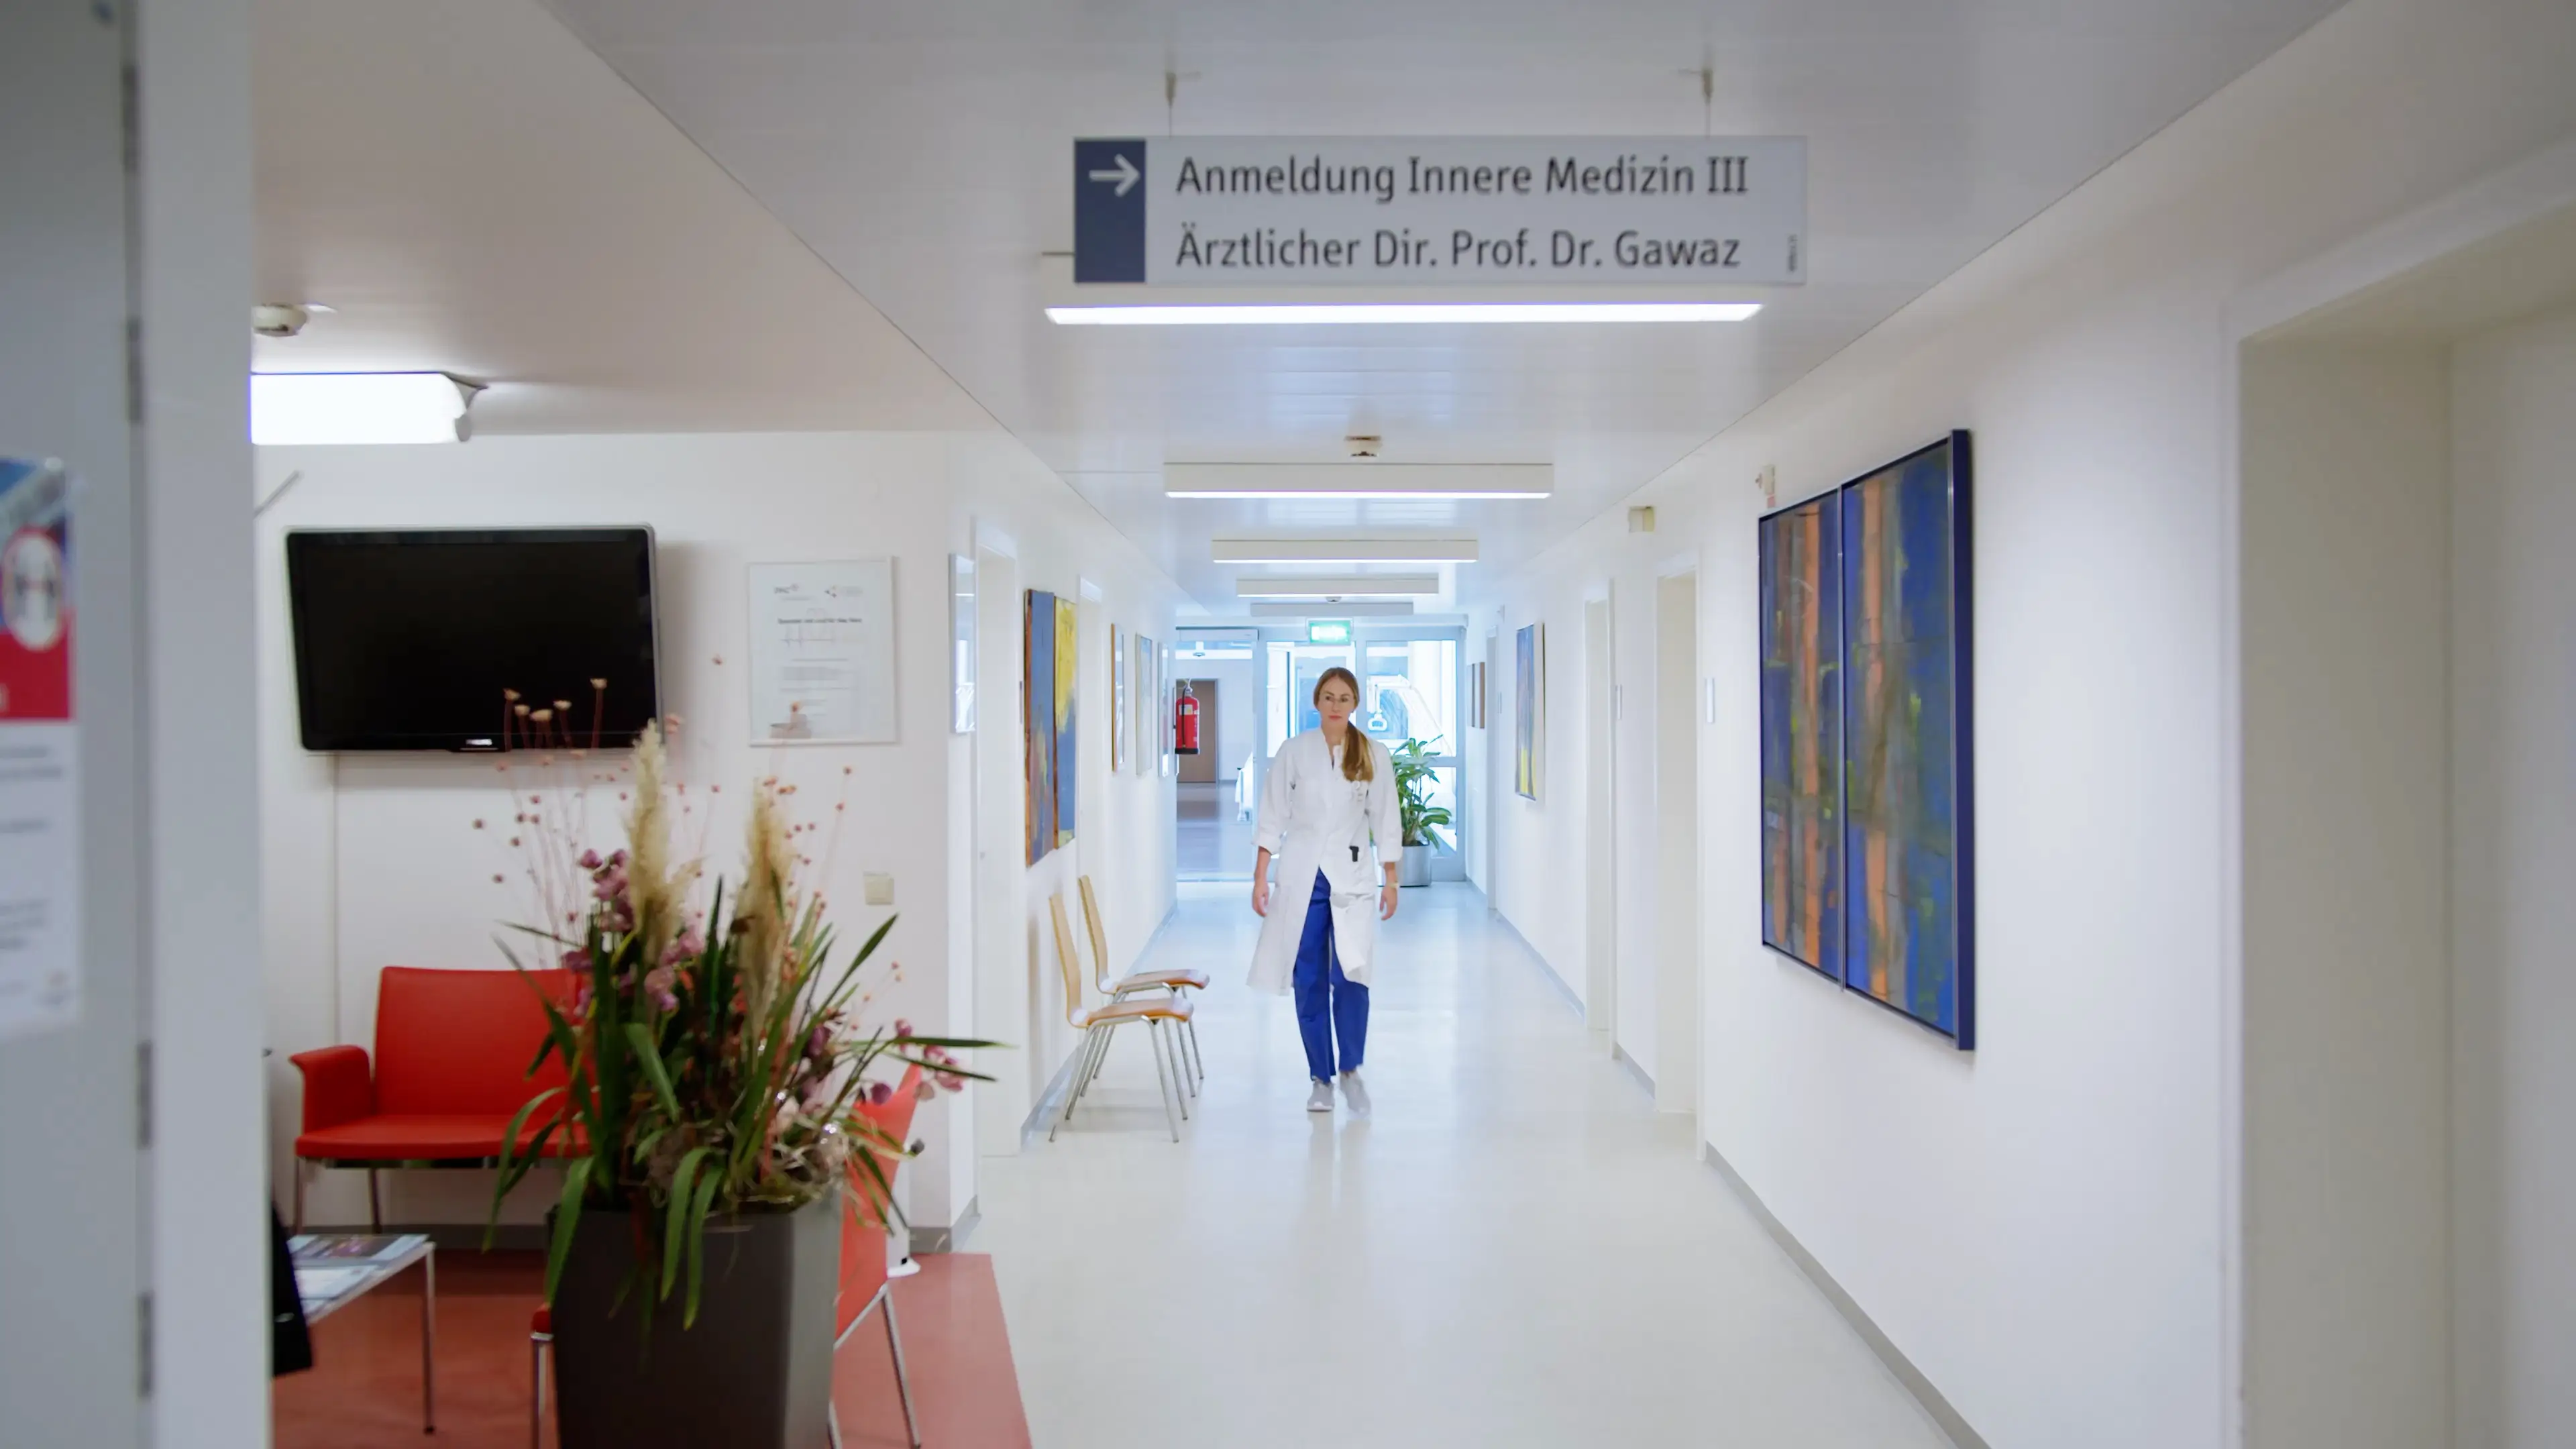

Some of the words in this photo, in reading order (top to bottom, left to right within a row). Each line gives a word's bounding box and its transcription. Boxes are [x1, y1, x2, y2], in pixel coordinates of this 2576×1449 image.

[1175, 155, 1395, 205] Anmeldung
[1409, 156, 1533, 195] Innere
[1546, 154, 1695, 195] Medizin
[1707, 156, 1749, 195] III
[1175, 222, 1361, 267] Ärztlicher
[1374, 228, 1438, 267] Dir.
[1452, 228, 1537, 267] Prof.
[1551, 229, 1602, 267] Dr.
[1614, 230, 1740, 267] Gawaz
